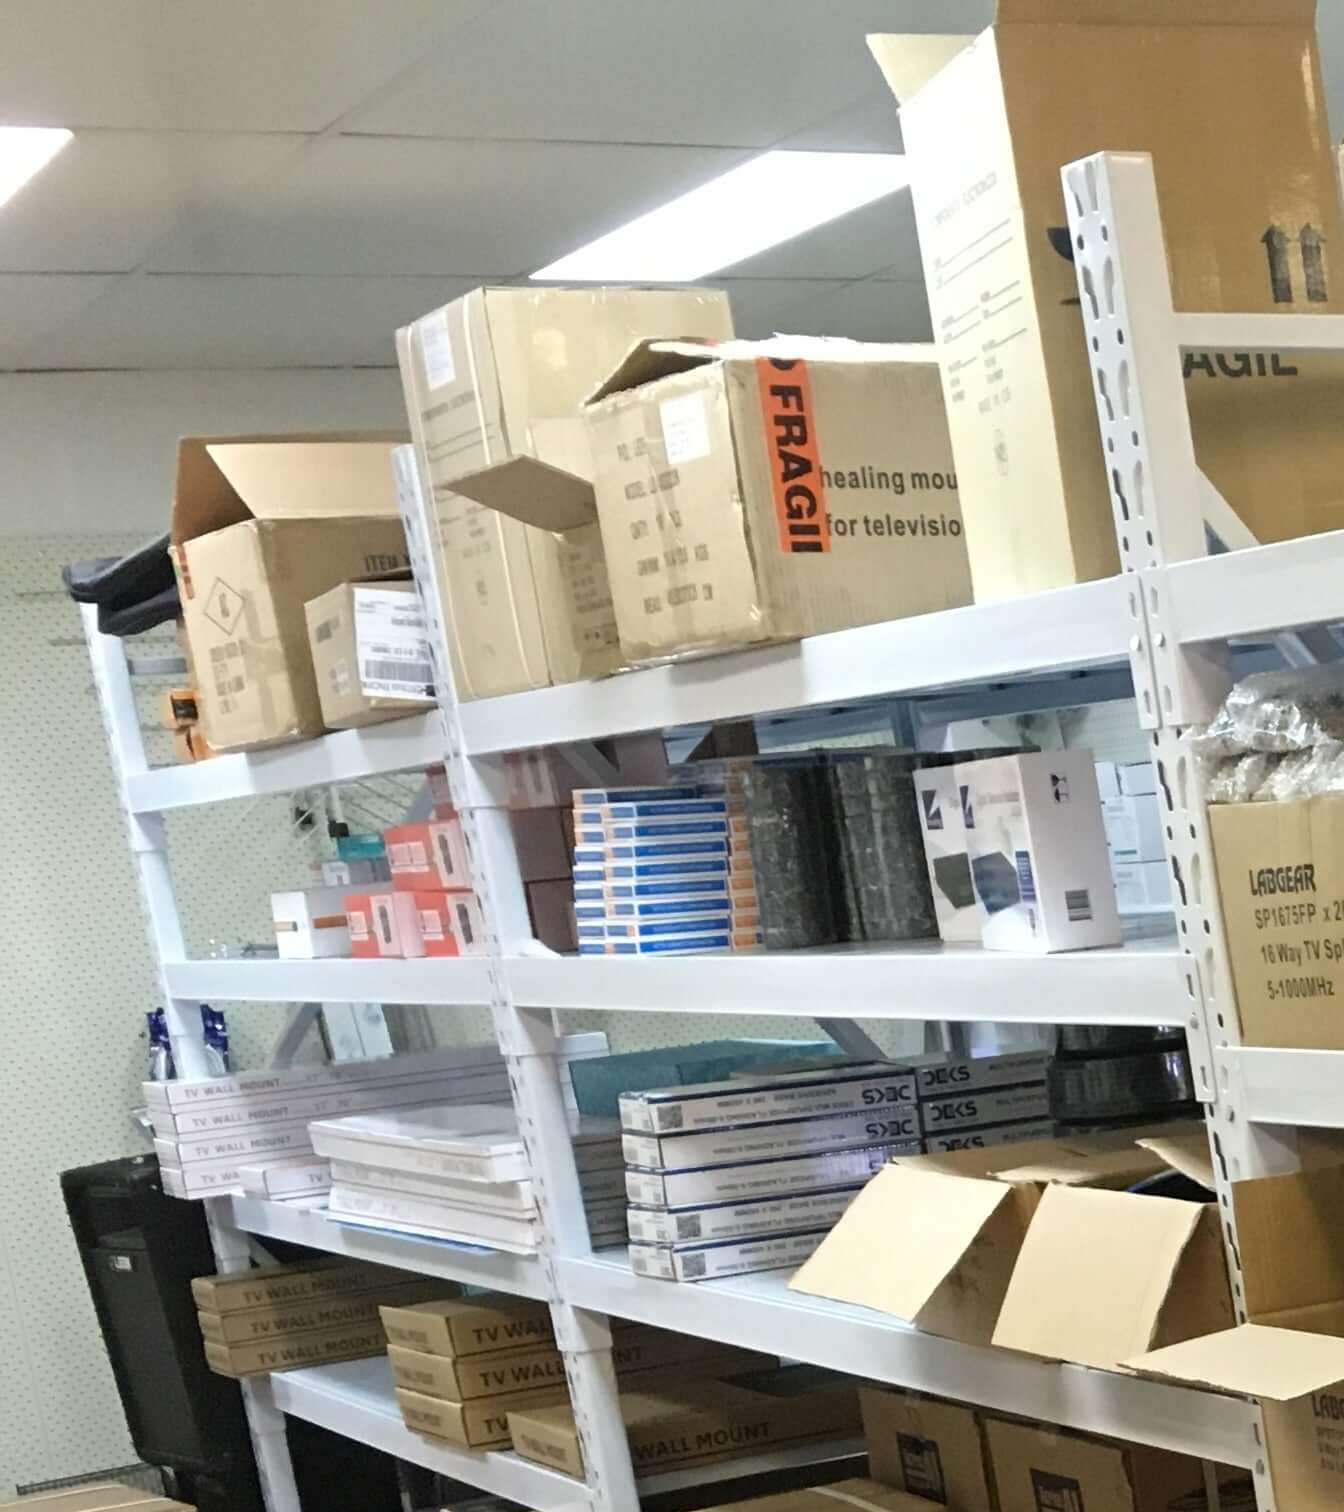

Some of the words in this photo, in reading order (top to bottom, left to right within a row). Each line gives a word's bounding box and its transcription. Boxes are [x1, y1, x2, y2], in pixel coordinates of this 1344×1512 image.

[820, 467, 904, 494] healing
[826, 514, 857, 537] for
[1249, 864, 1317, 897] LABGEAR
[1255, 906, 1317, 928] SP1675FP
[1261, 944, 1276, 963] 16
[1278, 943, 1303, 967] Way
[1305, 941, 1321, 960] TV
[1267, 978, 1334, 1001] 5-1000MHz
[252, 1320, 270, 1333] TV
[274, 1311, 314, 1331] WALL
[473, 1327, 499, 1346] TV
[257, 1350, 279, 1366] TV
[284, 1342, 328, 1362] WALL
[333, 1334, 382, 1356] MOUNT
[480, 1370, 507, 1388] TV
[695, 1421, 771, 1451] MOUNT
